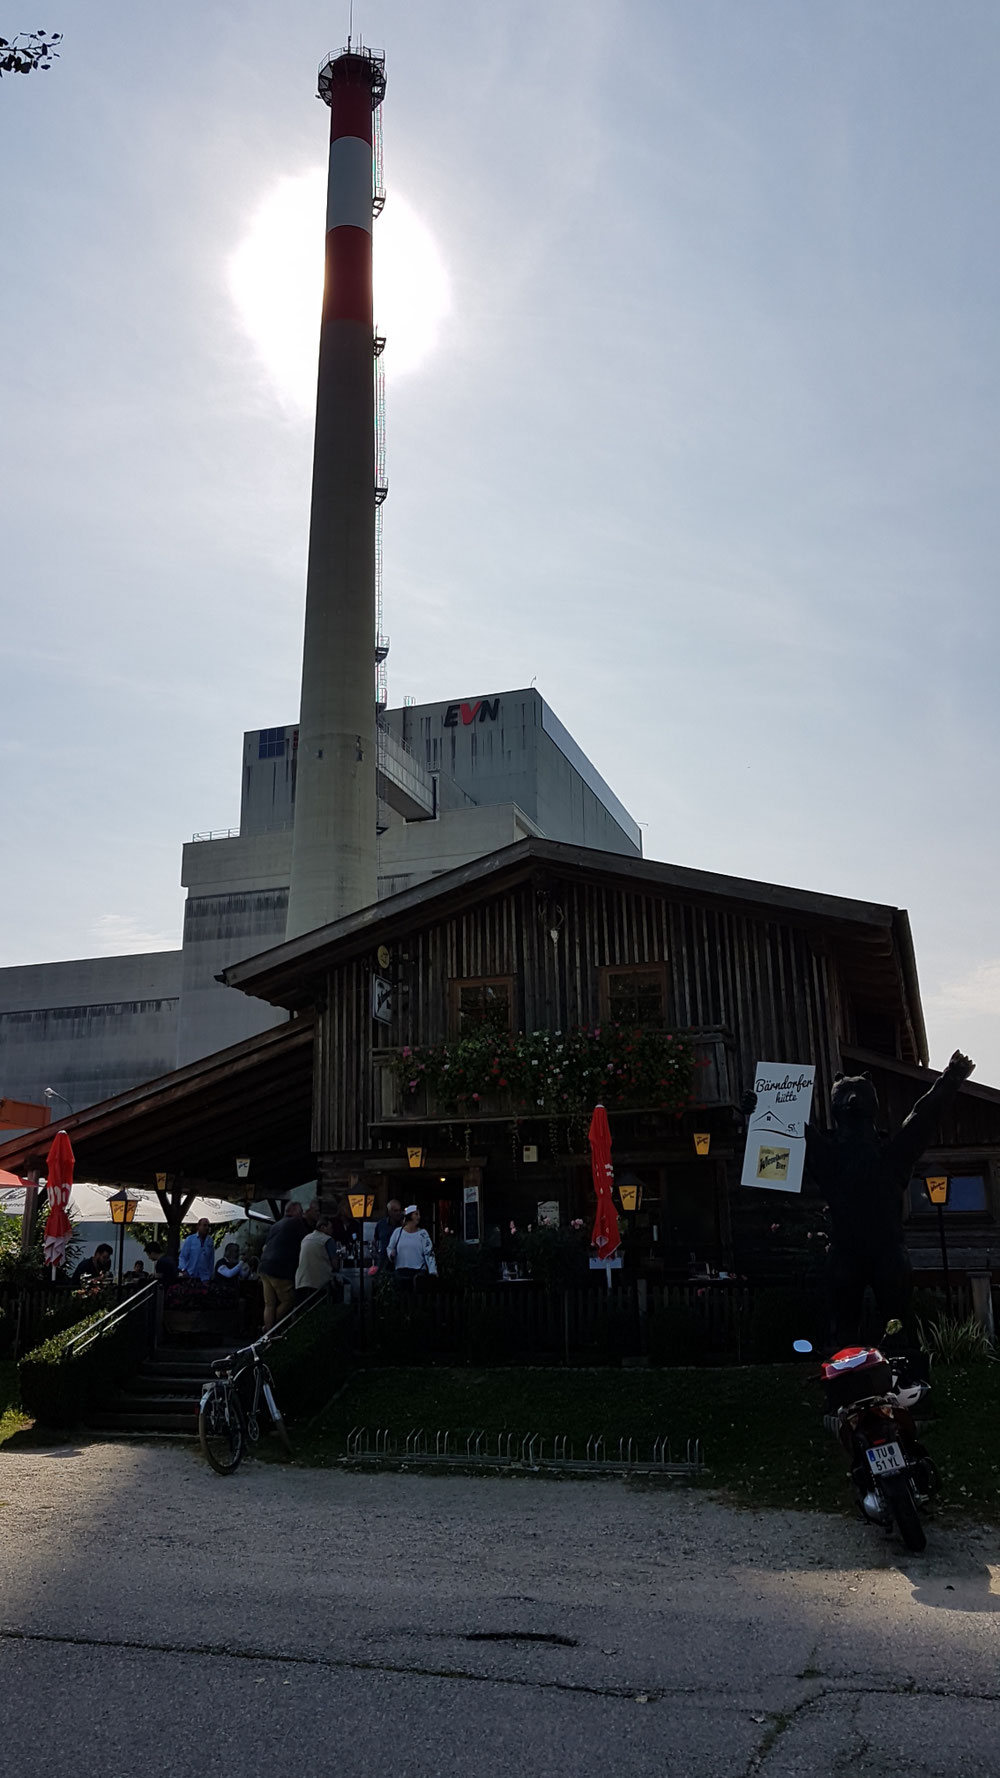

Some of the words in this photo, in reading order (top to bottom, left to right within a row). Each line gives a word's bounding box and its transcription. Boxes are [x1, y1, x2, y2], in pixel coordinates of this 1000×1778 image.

[444, 698, 500, 727] EVN
[756, 1074, 813, 1093] Bärndorfer
[776, 1091, 797, 1104] hütte
[876, 1447, 888, 1459] TU
[876, 1460, 887, 1471] 51
[888, 1457, 900, 1468] YL
